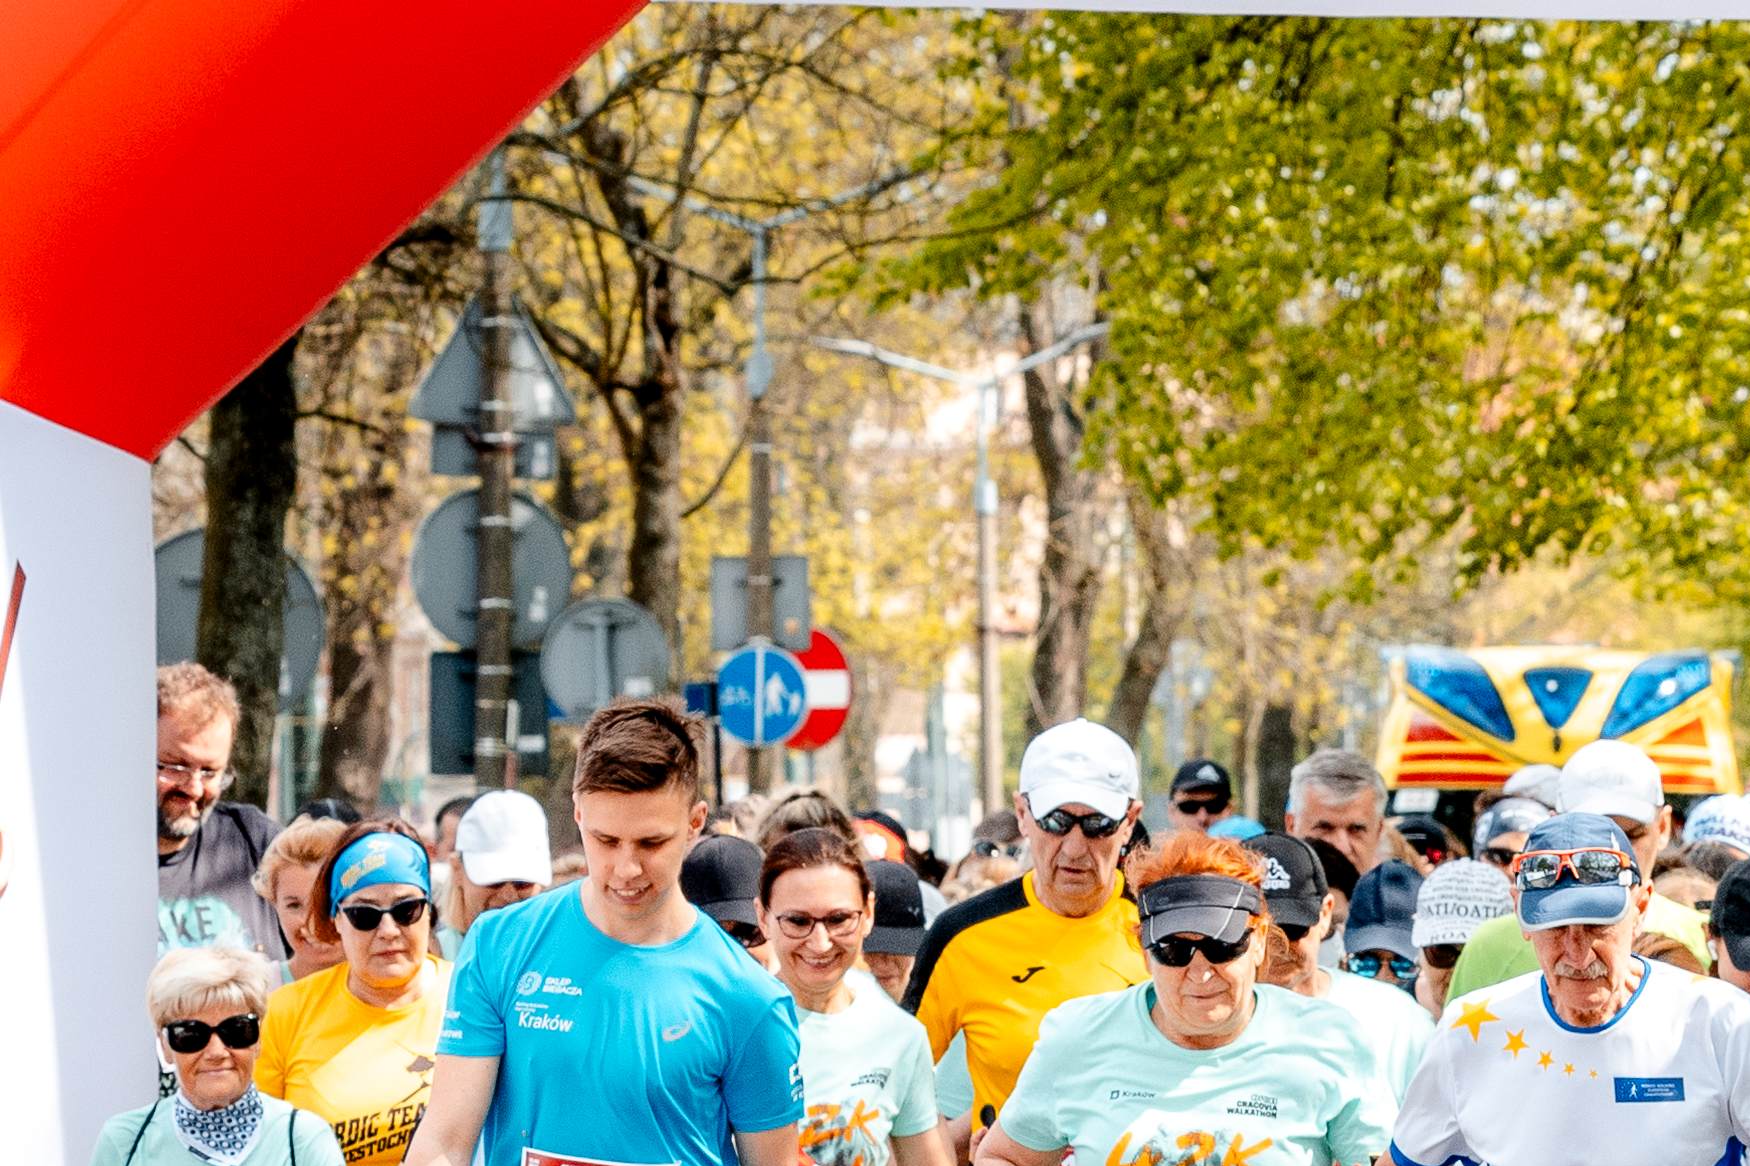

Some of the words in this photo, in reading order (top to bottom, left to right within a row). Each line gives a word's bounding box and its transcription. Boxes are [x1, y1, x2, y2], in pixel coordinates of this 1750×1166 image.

[518, 1011, 573, 1032] Kraków
[1236, 1100, 1277, 1111] CRACOVIA
[1227, 1107, 1277, 1119] WALKATHON
